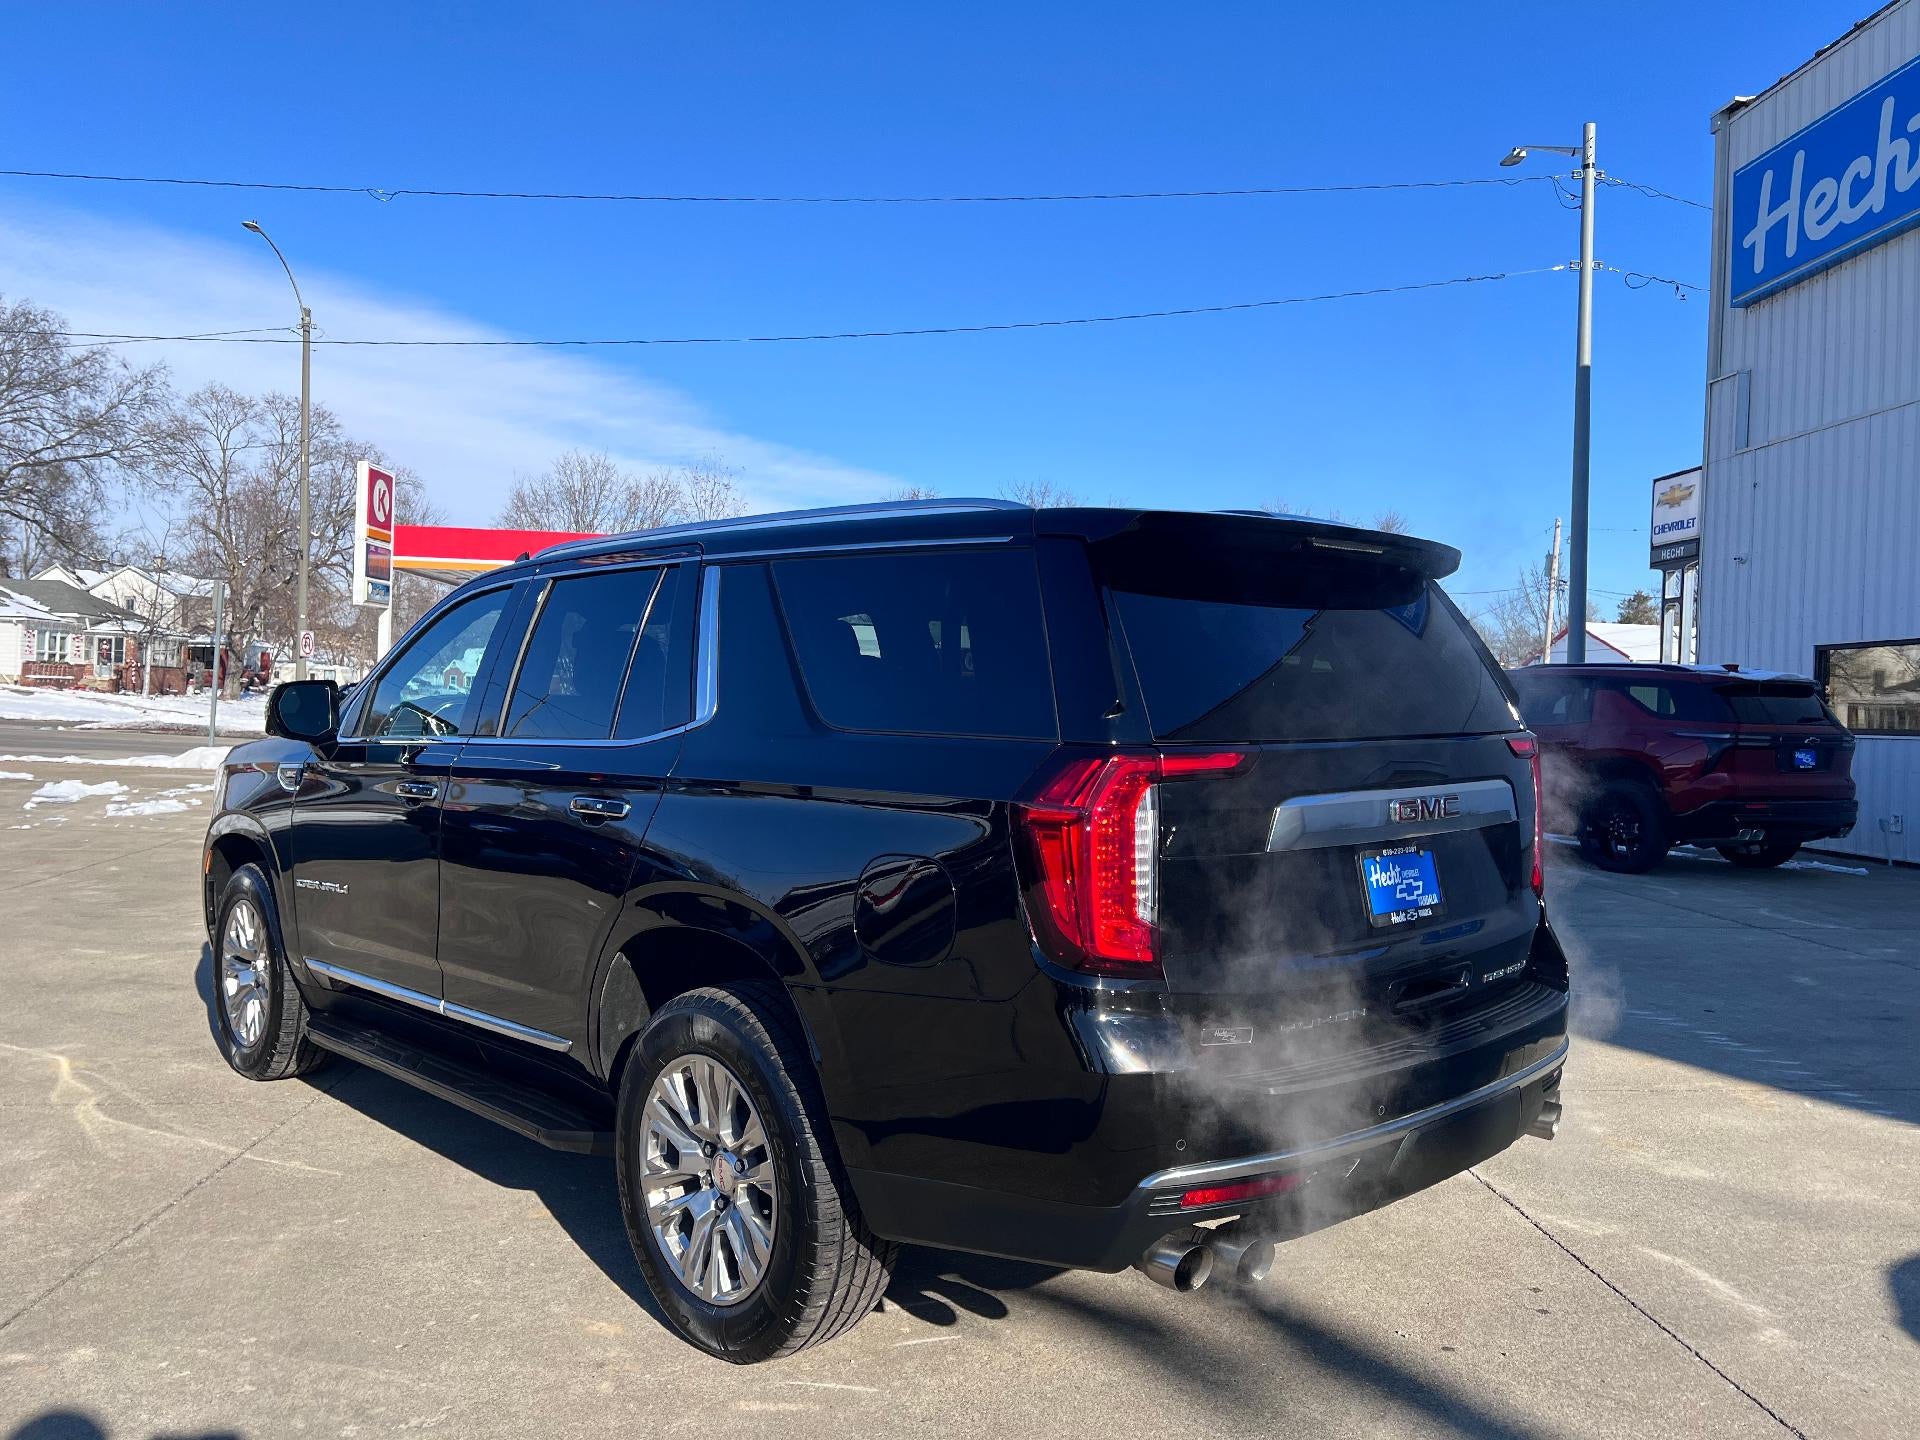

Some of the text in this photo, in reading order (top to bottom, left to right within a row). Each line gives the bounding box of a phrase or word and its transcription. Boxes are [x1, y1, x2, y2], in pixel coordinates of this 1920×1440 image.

[377, 487, 387, 518] K
[1653, 517, 1697, 536] CHEVROLET
[1661, 546, 1685, 560] HECHT
[1390, 795, 1460, 824] GMC
[1370, 862, 1402, 888] Hecht
[718, 1156, 726, 1191] GMC
